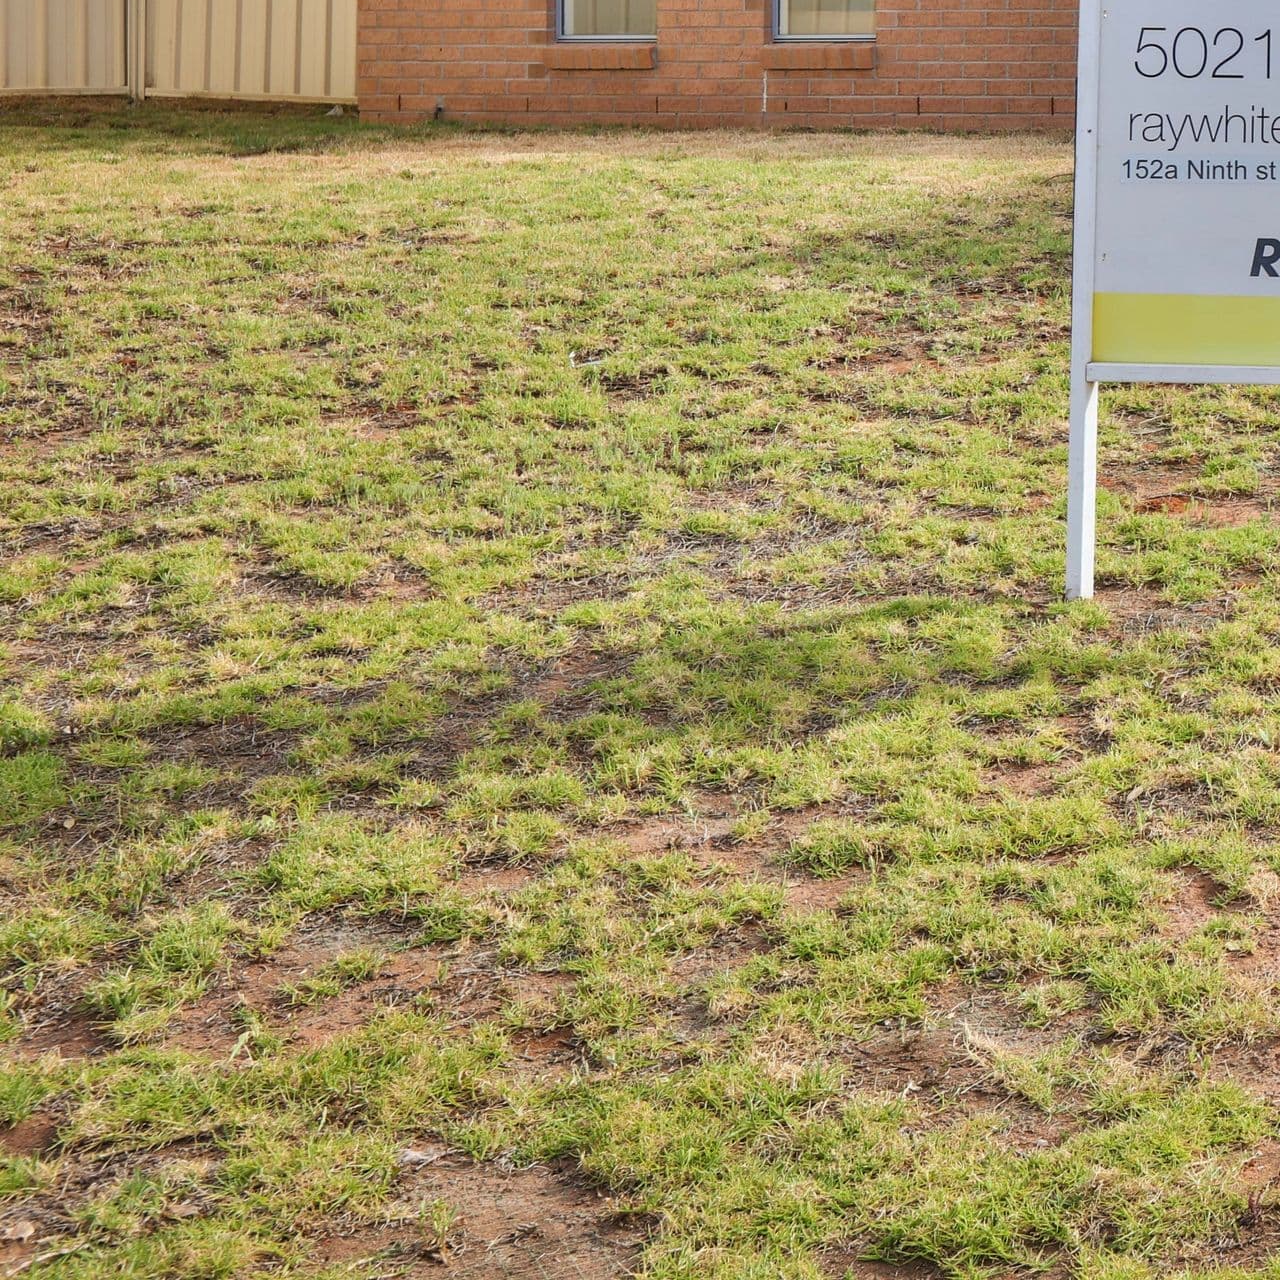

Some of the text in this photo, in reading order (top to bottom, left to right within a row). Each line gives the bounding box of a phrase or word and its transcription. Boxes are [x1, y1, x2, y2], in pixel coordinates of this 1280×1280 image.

[1134, 27, 1273, 81] 5021
[1122, 159, 1178, 180] 152a
[1187, 160, 1247, 181] Ninth
[1255, 161, 1277, 181] st
